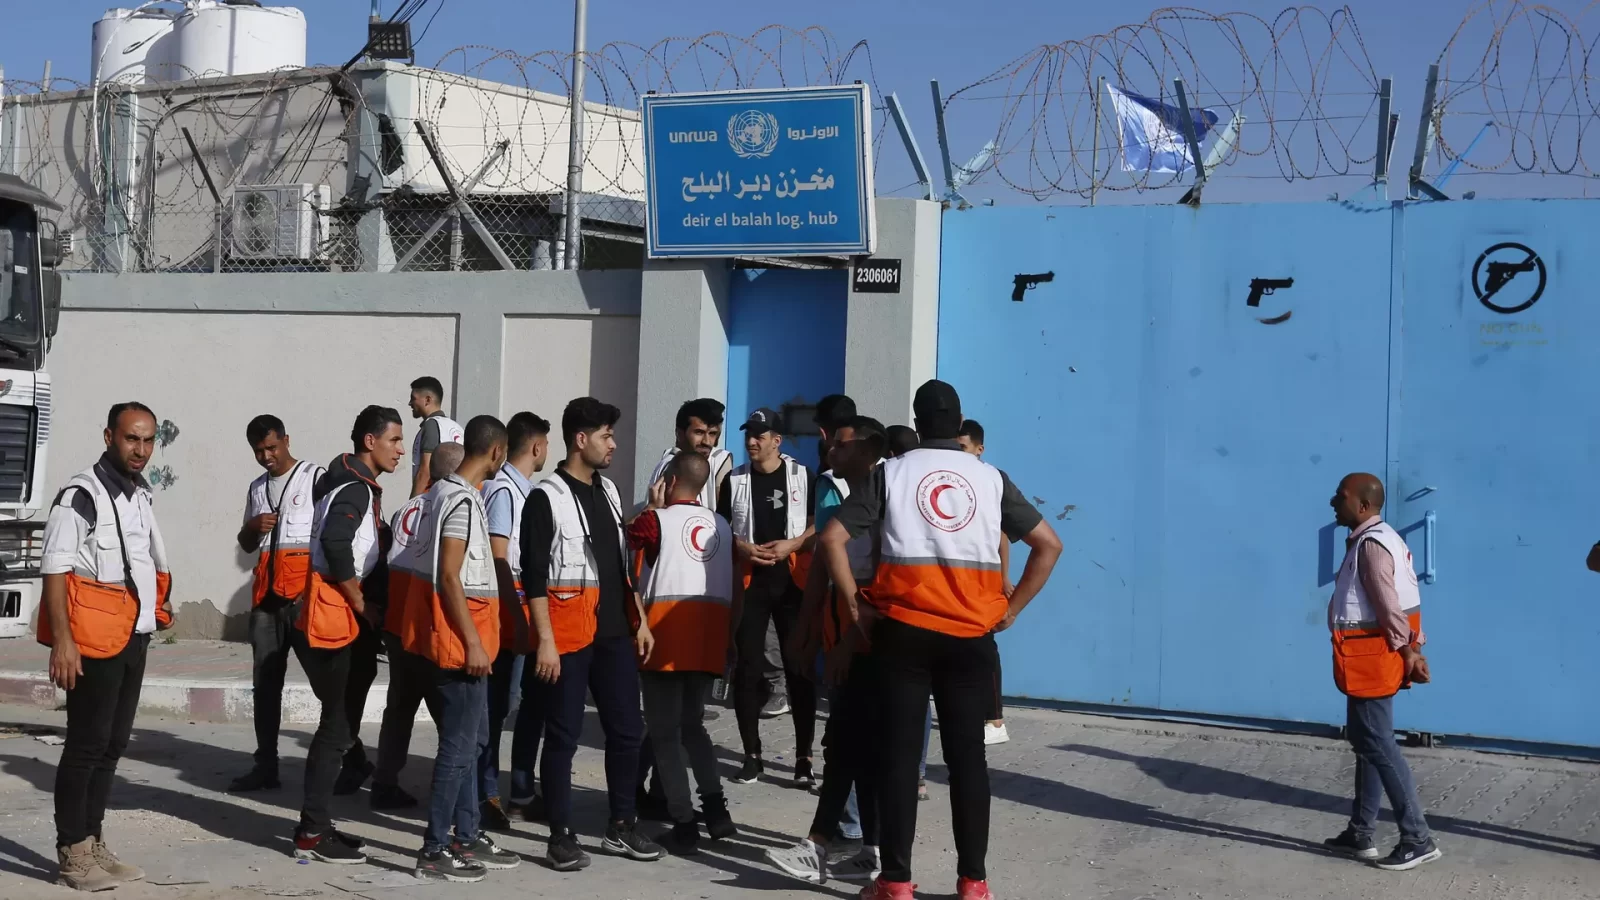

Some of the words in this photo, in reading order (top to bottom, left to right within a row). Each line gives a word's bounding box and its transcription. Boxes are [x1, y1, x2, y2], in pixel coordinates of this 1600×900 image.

[669, 130, 718, 143] unrwa
[681, 170, 731, 202] البلح
[733, 173, 771, 201] دير
[775, 167, 835, 198] مخزن
[682, 213, 711, 227] deir
[714, 213, 727, 227] el
[731, 212, 772, 226] balah
[776, 211, 804, 229] log.
[808, 211, 838, 225] hub
[856, 267, 898, 283] 2306061
